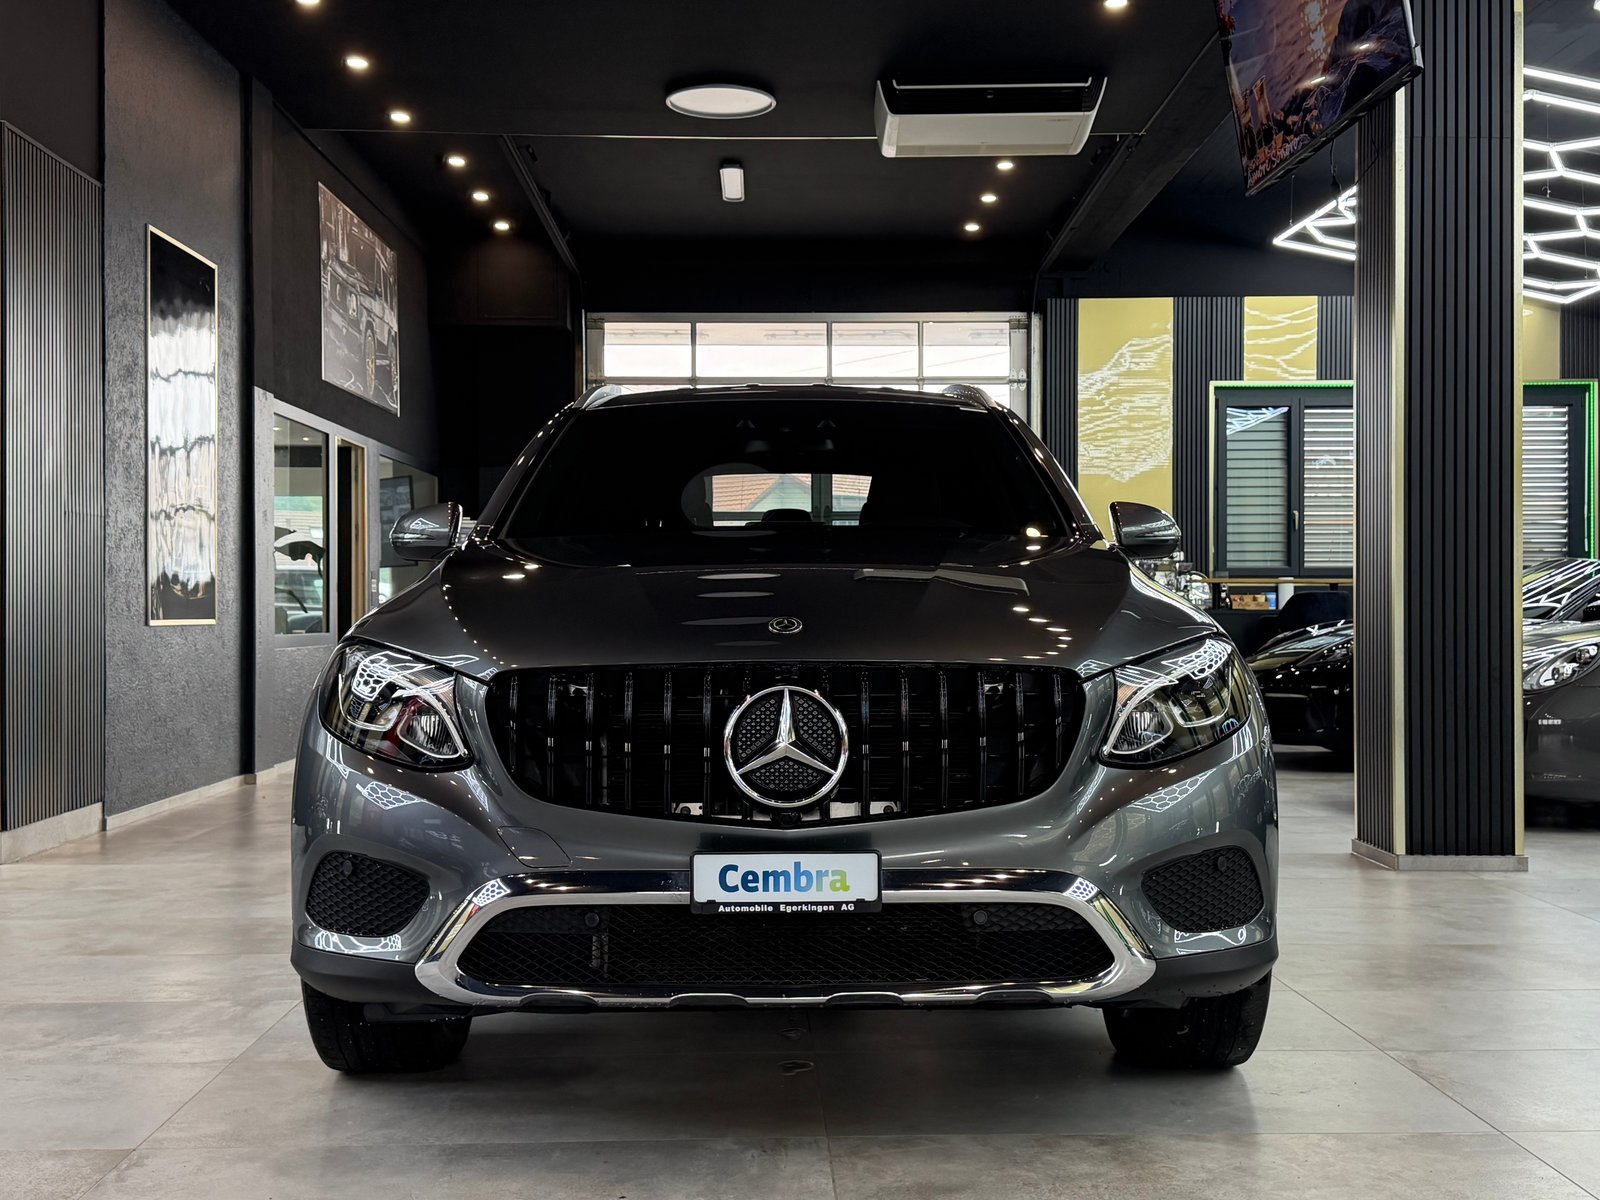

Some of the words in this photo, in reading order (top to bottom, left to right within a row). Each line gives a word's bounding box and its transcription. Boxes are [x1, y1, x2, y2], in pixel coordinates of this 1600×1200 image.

[718, 861, 850, 893] Cembra
[718, 904, 774, 912] Automobile
[780, 904, 834, 913] Egerkingen
[841, 903, 855, 911] AG
